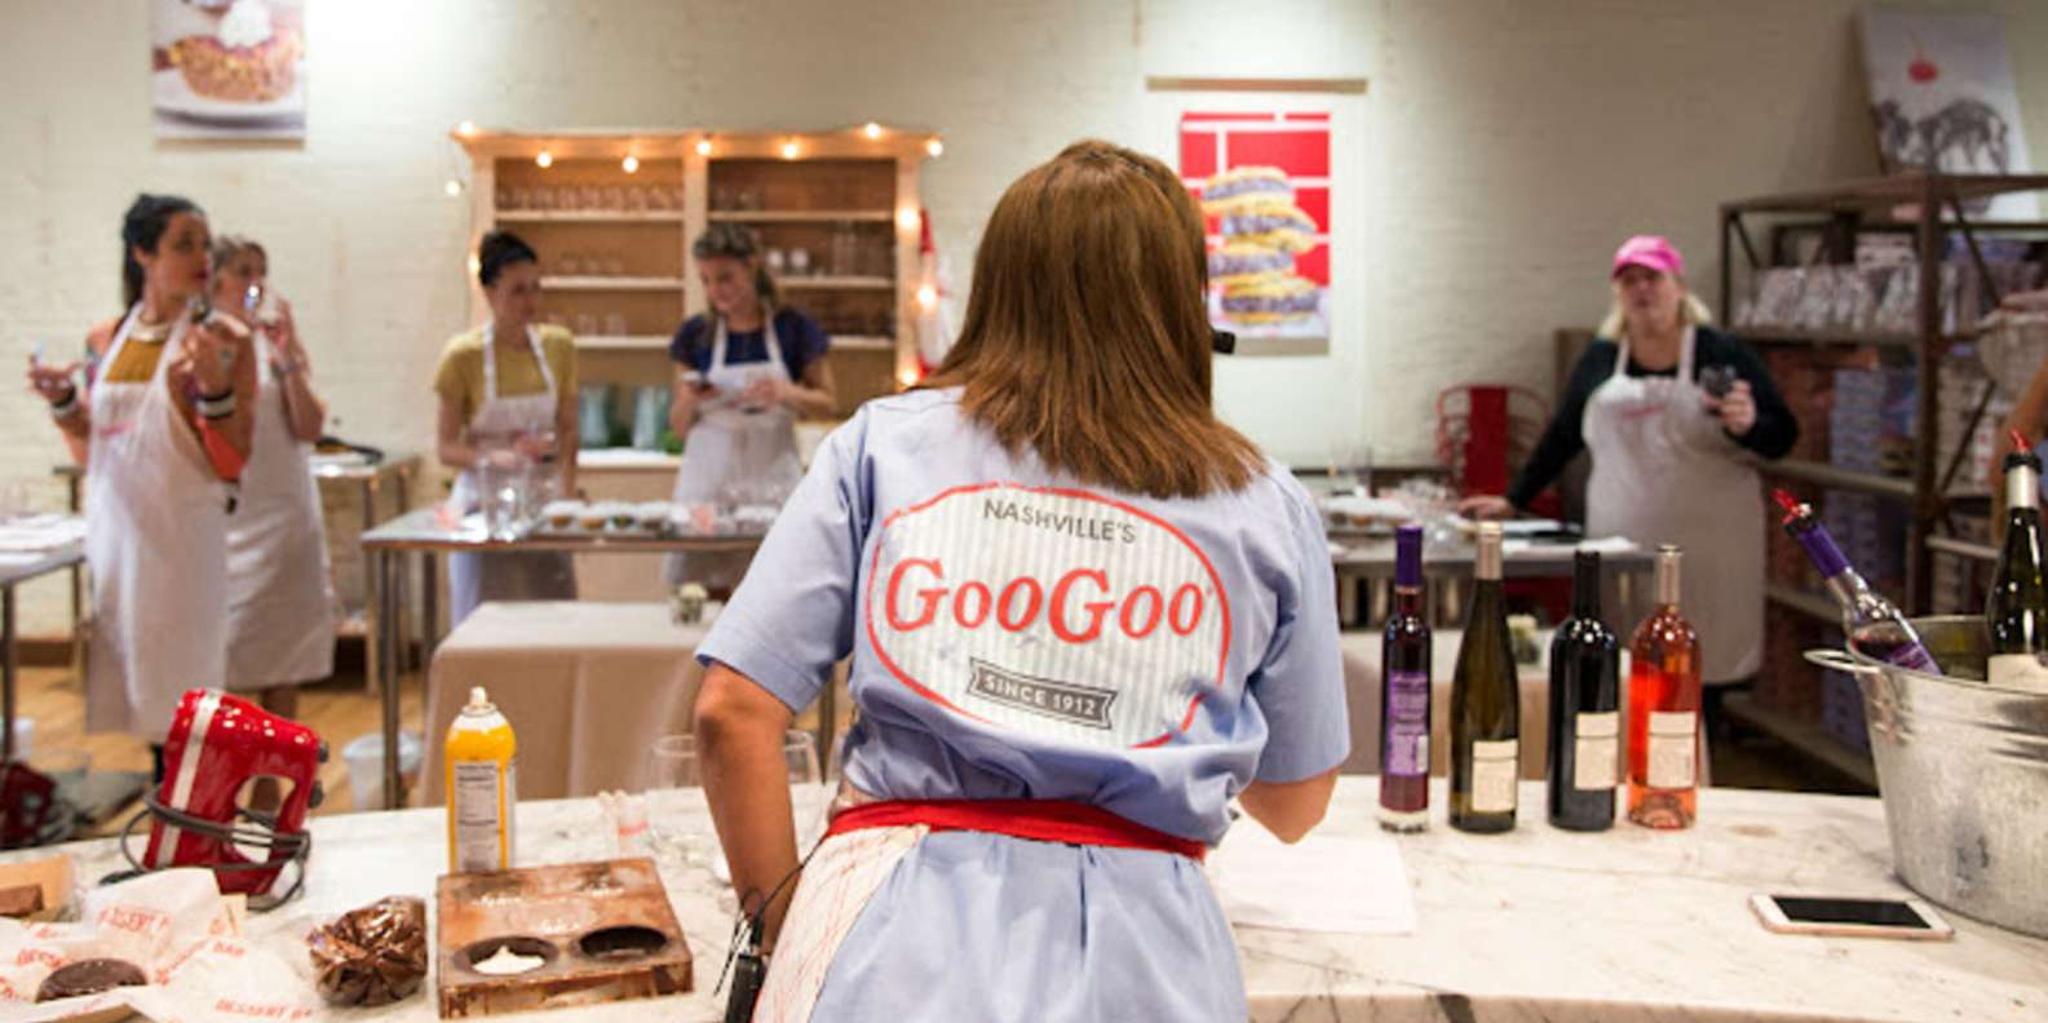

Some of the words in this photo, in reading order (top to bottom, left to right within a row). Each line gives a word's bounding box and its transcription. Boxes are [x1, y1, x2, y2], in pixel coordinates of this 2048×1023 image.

[984, 499, 1137, 544] NASHVILLE'S
[983, 674, 1049, 708] SINCE
[1052, 691, 1096, 717] 1912
